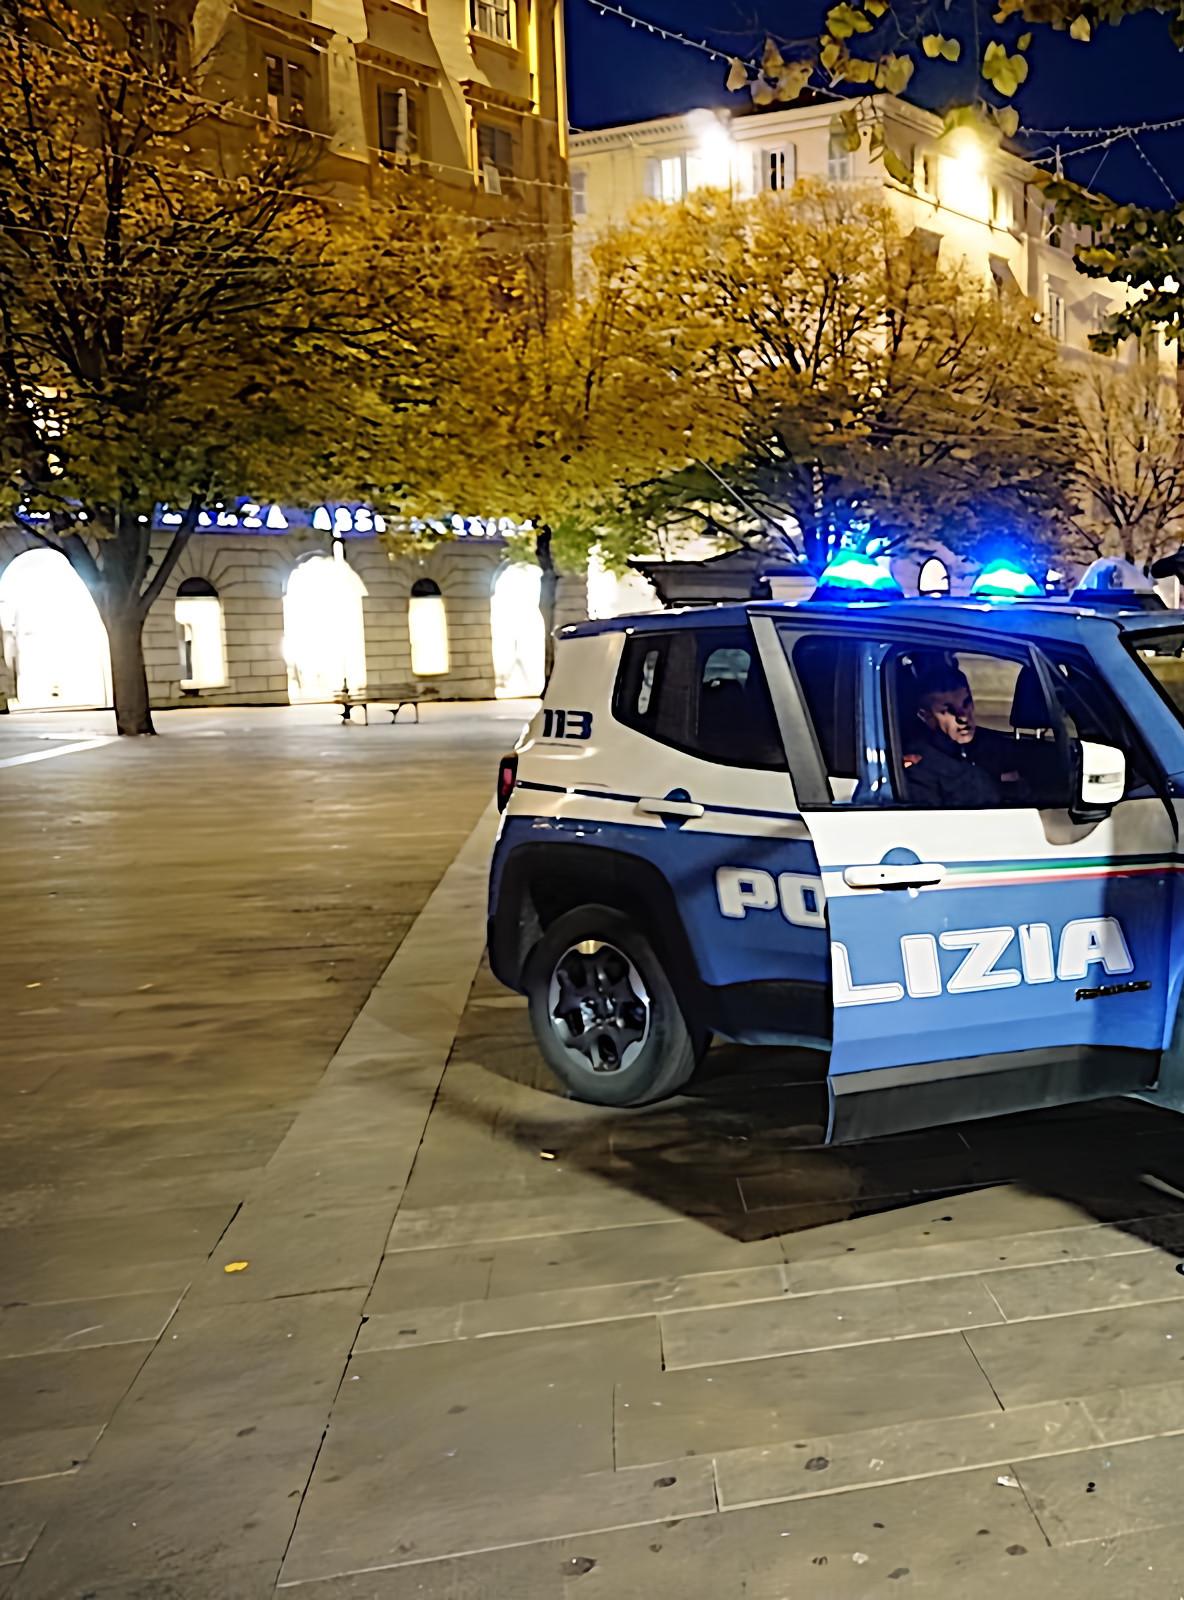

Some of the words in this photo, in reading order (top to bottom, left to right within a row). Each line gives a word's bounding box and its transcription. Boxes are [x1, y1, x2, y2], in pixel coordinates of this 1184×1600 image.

[543, 709, 593, 740] 113
[715, 865, 828, 930] PO
[831, 916, 1135, 1008] LIZIA
